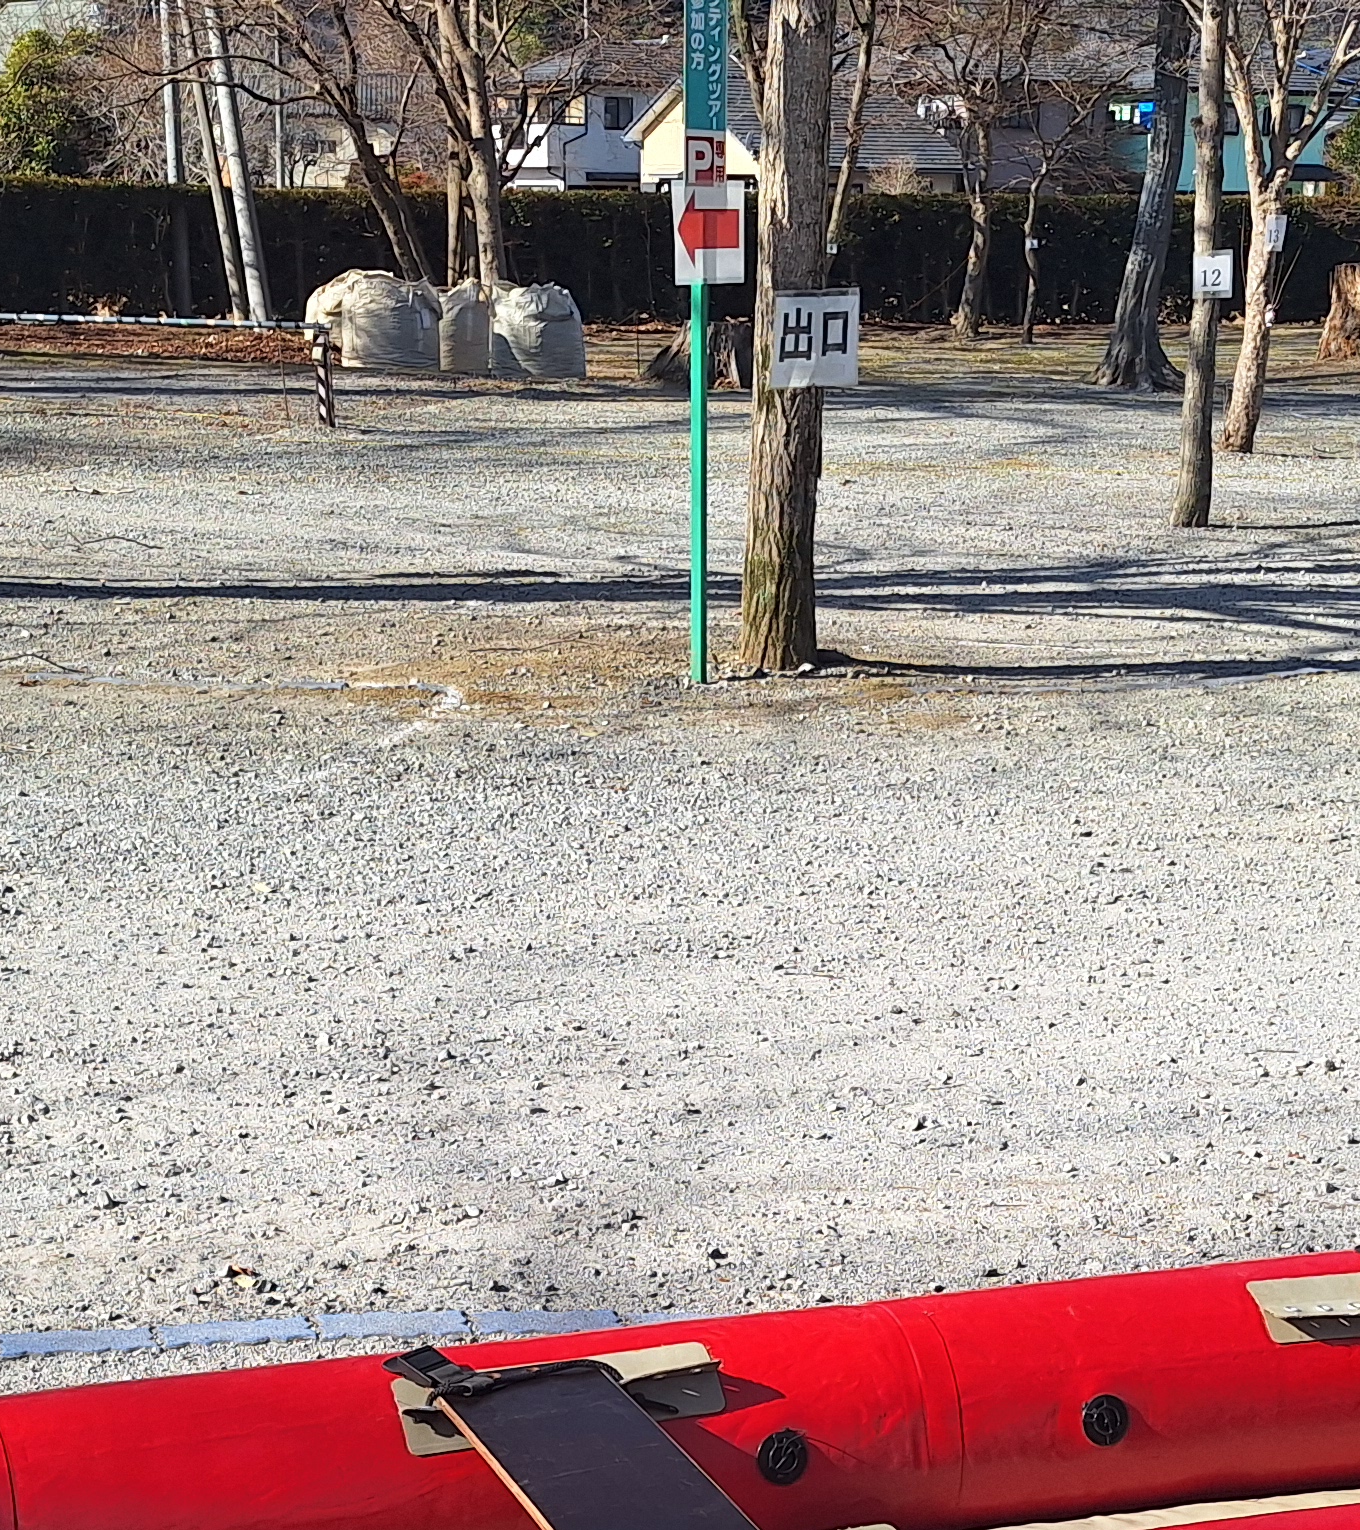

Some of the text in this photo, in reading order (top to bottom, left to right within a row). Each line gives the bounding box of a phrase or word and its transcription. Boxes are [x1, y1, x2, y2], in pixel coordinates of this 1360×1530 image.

[688, 140, 712, 184] P
[1268, 229, 1280, 244] 13
[1201, 268, 1222, 288] 12
[779, 307, 849, 363] 出口
